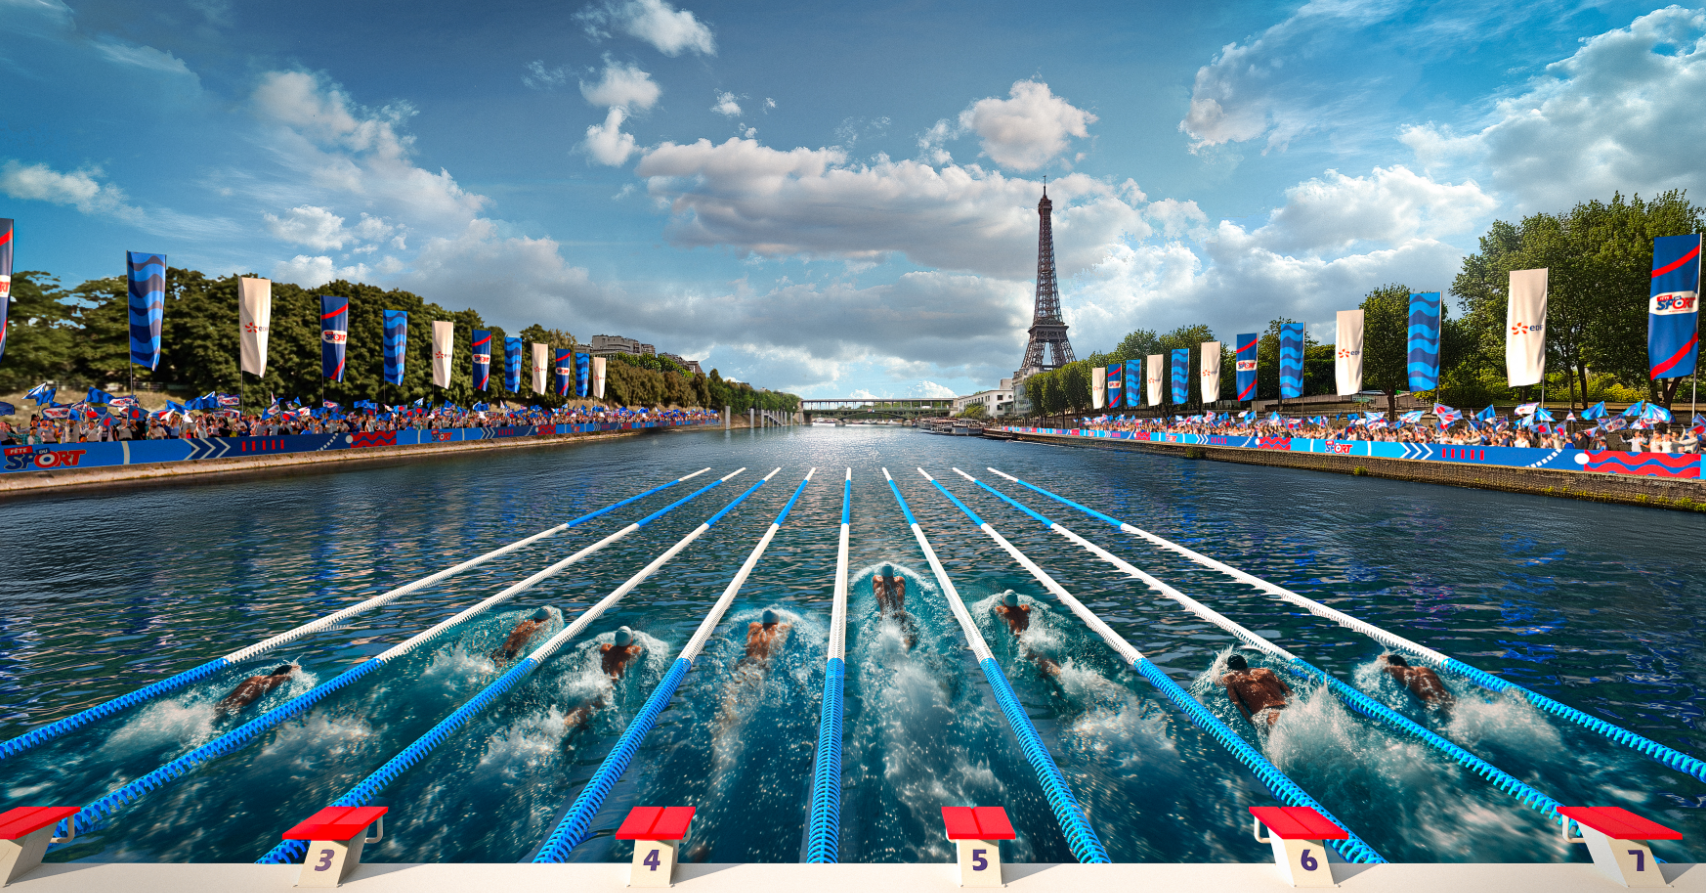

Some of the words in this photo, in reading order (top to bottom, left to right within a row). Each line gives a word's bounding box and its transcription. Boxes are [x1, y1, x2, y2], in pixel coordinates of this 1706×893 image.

[1656, 297, 1696, 310] SPORT
[4, 449, 87, 470] SPORT
[10, 447, 28, 455] FÊTE
[314, 849, 335, 872] 3
[643, 849, 661, 872] 4
[972, 849, 988, 872] 5
[1300, 849, 1319, 872] 6
[1627, 849, 1645, 872] 7
